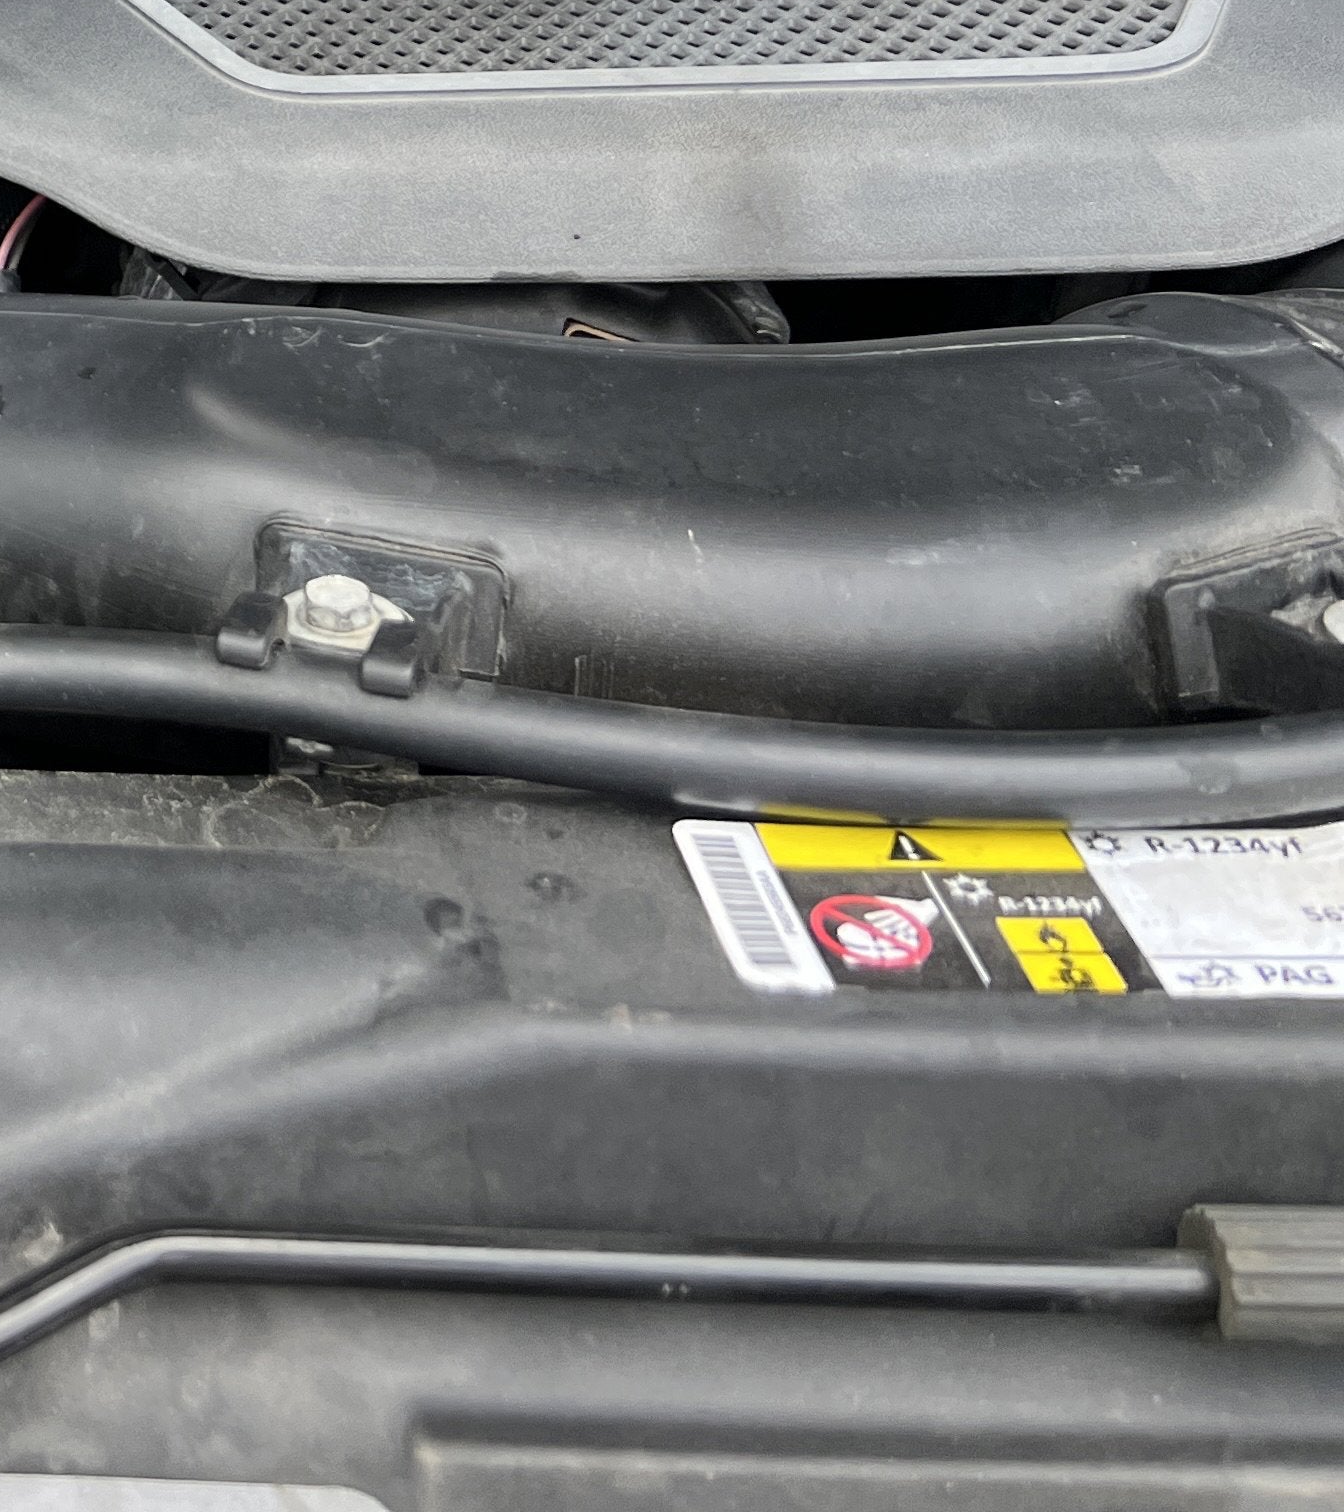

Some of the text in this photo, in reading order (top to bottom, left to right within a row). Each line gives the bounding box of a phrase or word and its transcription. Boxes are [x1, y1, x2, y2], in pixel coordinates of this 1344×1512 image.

[1144, 835, 1304, 857] R-1234yf
[998, 895, 1103, 919] R-1234yf
[1254, 964, 1335, 986] PAG
